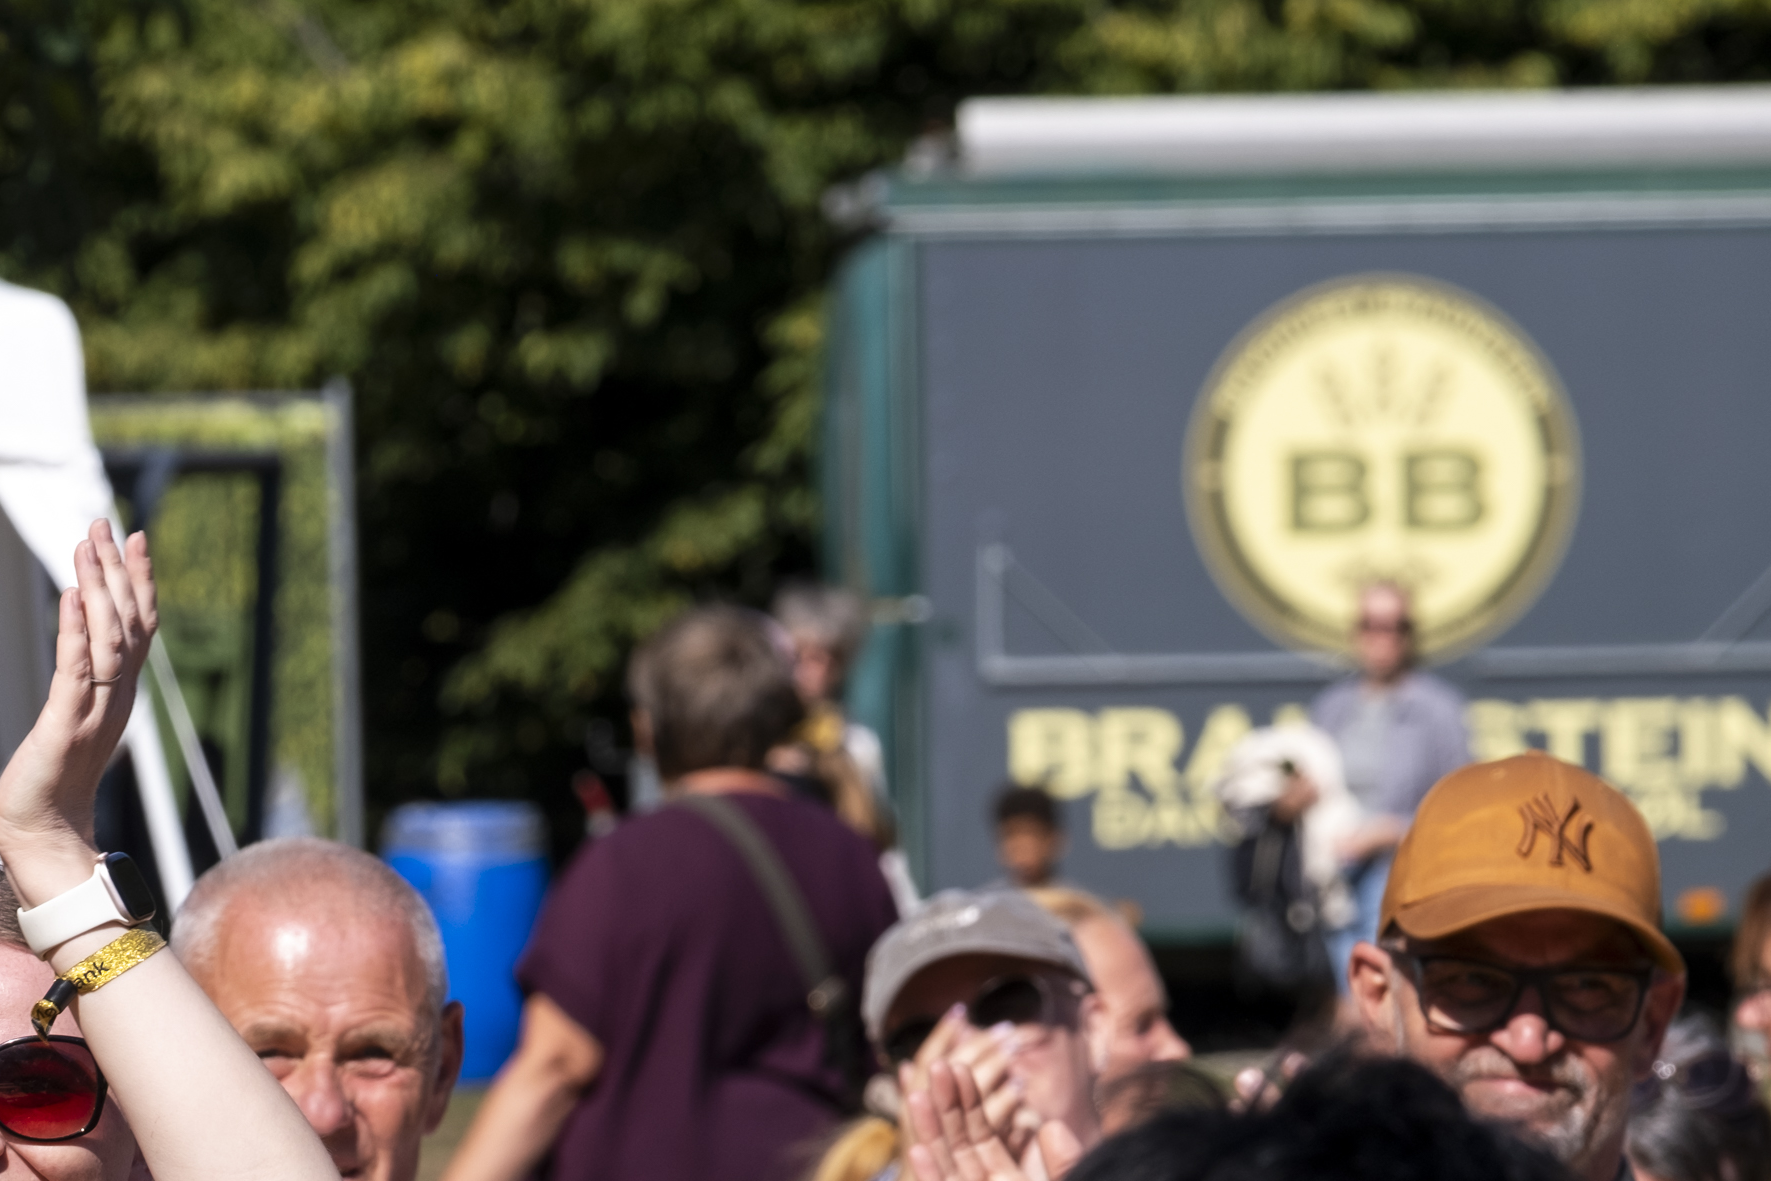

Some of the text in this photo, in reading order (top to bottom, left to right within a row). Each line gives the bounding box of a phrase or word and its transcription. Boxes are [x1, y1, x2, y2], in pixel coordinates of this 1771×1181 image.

[1288, 447, 1486, 532] BB
[1515, 792, 1594, 873] NY
[74, 961, 109, 989] ank
